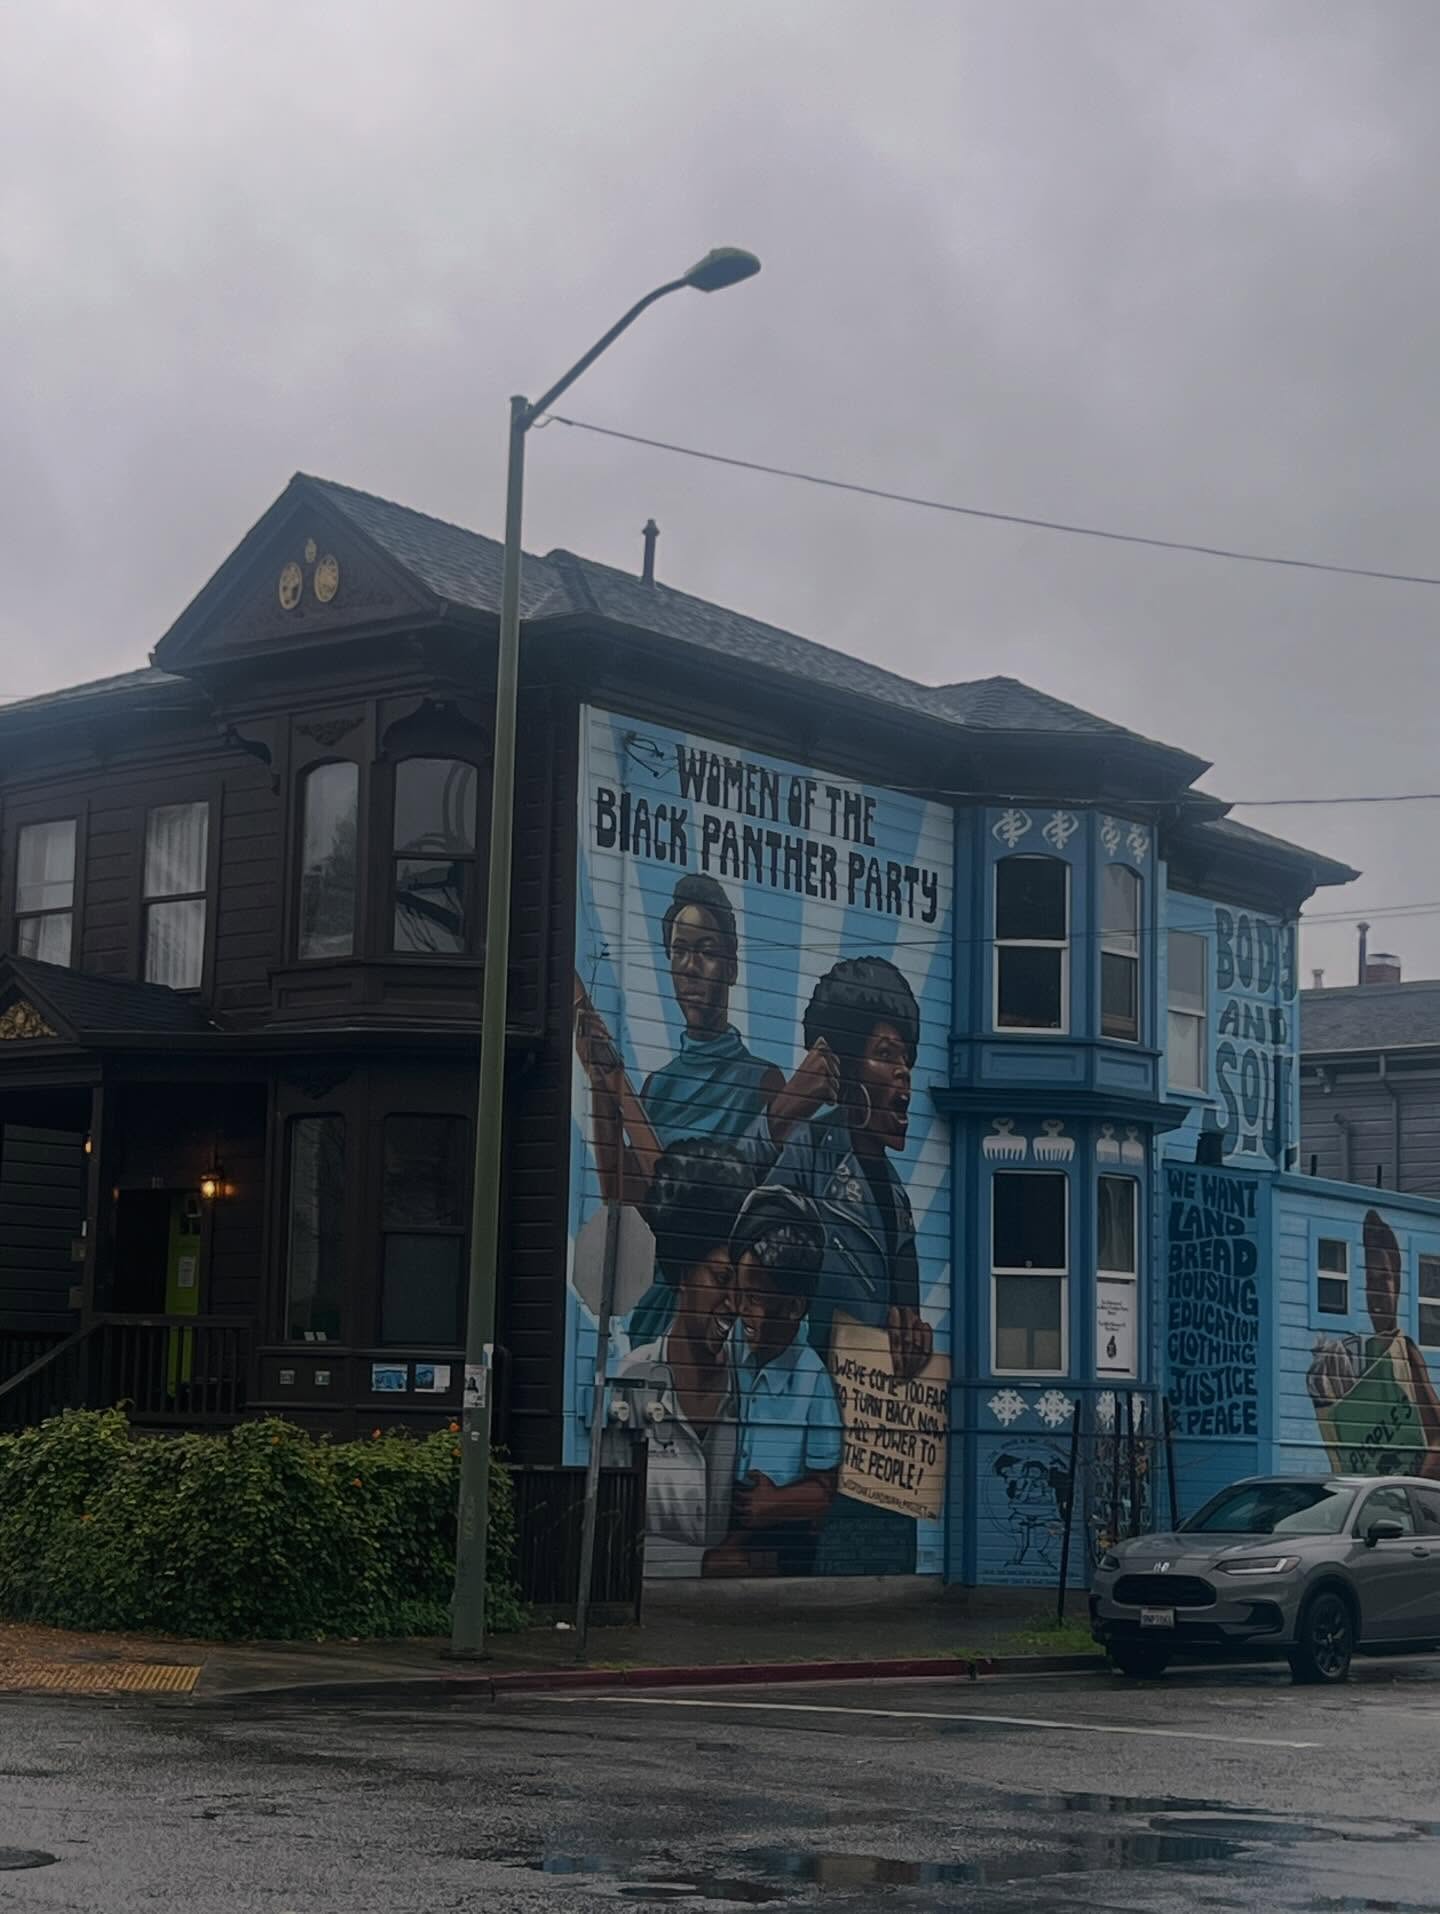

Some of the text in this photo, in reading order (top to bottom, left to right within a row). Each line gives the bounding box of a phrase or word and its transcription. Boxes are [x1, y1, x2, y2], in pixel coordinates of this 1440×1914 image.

[675, 743, 878, 848] WOMEN OF THE
[702, 813, 838, 902] PANTHER
[847, 850, 939, 925] PARTY
[1214, 906, 1297, 1002] BODY
[1218, 999, 1288, 1046] AND
[1167, 1168, 1259, 1219] WE WANT
[1167, 1201, 1246, 1242] LAND
[1167, 1237, 1258, 1278] BREAD
[1167, 1270, 1259, 1317] HOUSING
[1167, 1301, 1259, 1343] EDUCATION
[1167, 1330, 1257, 1367] CLOTHING
[1167, 1366, 1259, 1407] JUSTICE
[852, 1388, 882, 1419] TURN
[885, 1399, 916, 1429] BACK
[1186, 1400, 1259, 1435] PEACE
[845, 1442, 865, 1474] THE
[848, 1418, 936, 1466] ALL POWER TO
